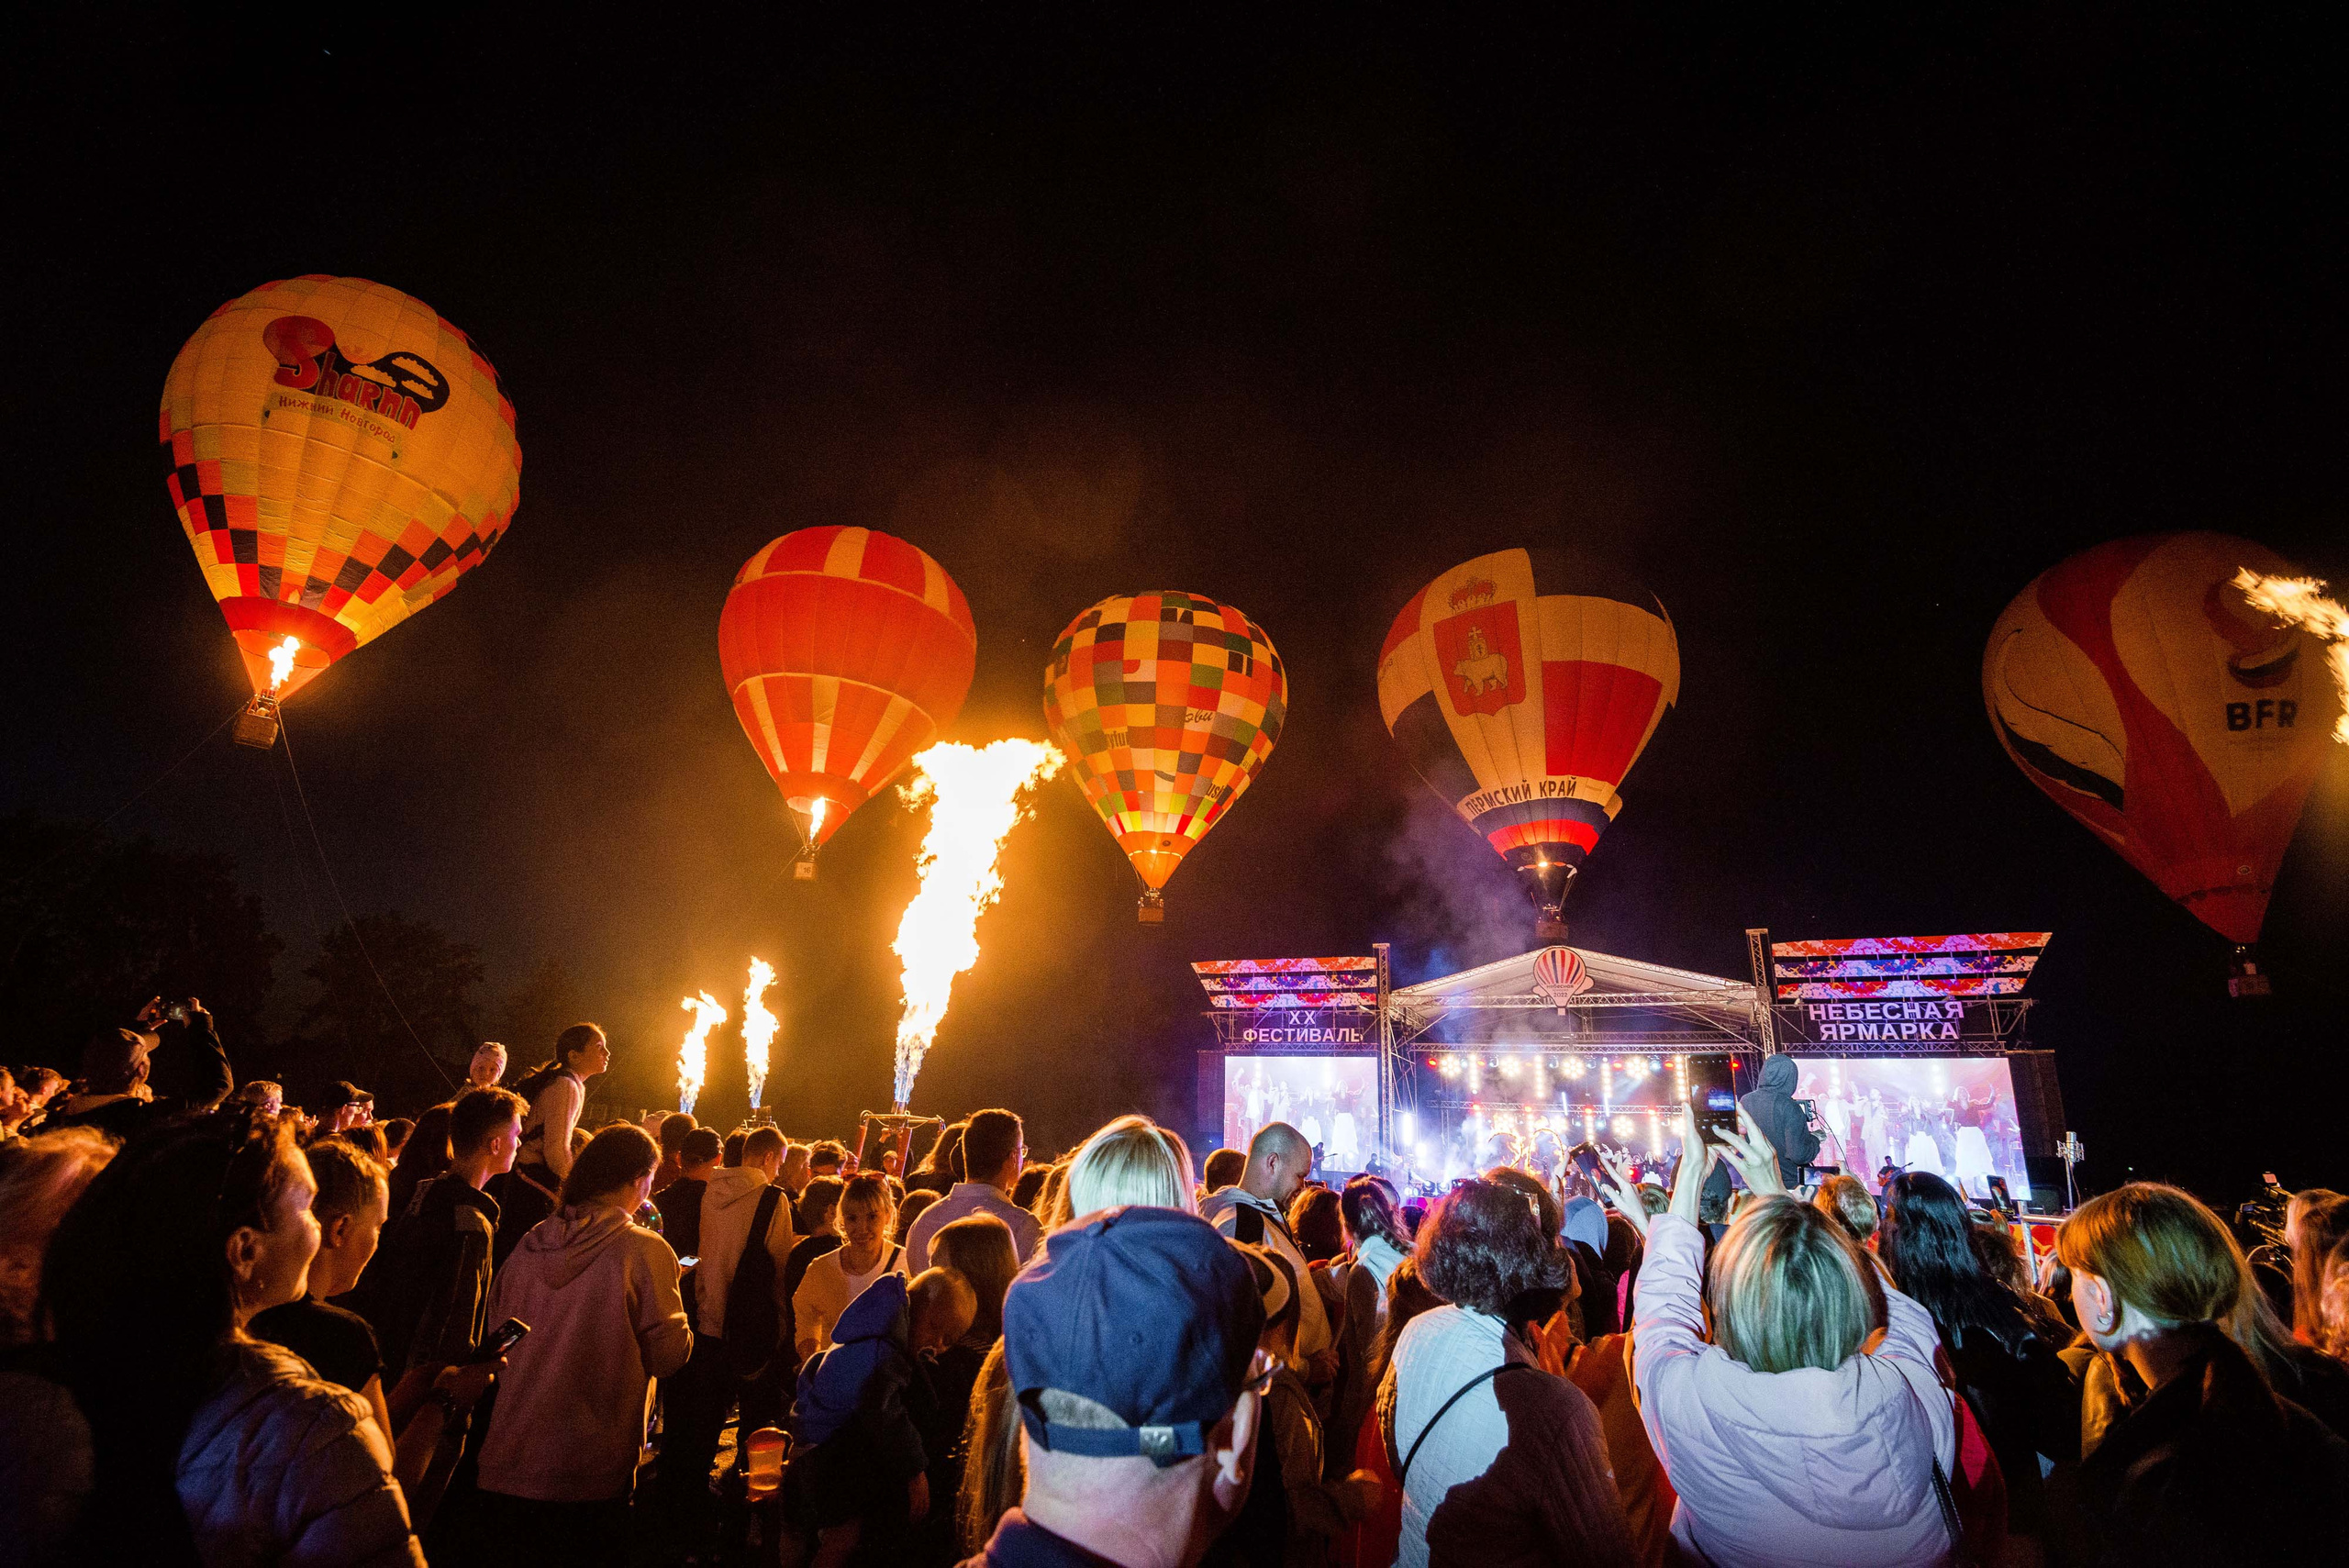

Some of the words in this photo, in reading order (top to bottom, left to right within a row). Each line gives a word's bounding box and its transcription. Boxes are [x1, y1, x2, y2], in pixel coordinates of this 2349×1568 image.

[279, 395, 334, 416] Нижний
[339, 407, 396, 444] Новгород
[1465, 779, 1532, 816] ПЕРМСКИЙ
[1539, 776, 1577, 797] КРАЙ
[803, 866, 812, 874] 16
[1809, 1001, 1965, 1020] НЕБЕСНАЯ
[1242, 1028, 1364, 1042] ФЕСТИВАЛЬ
[1820, 1022, 1959, 1041] ЯРМАРКА
